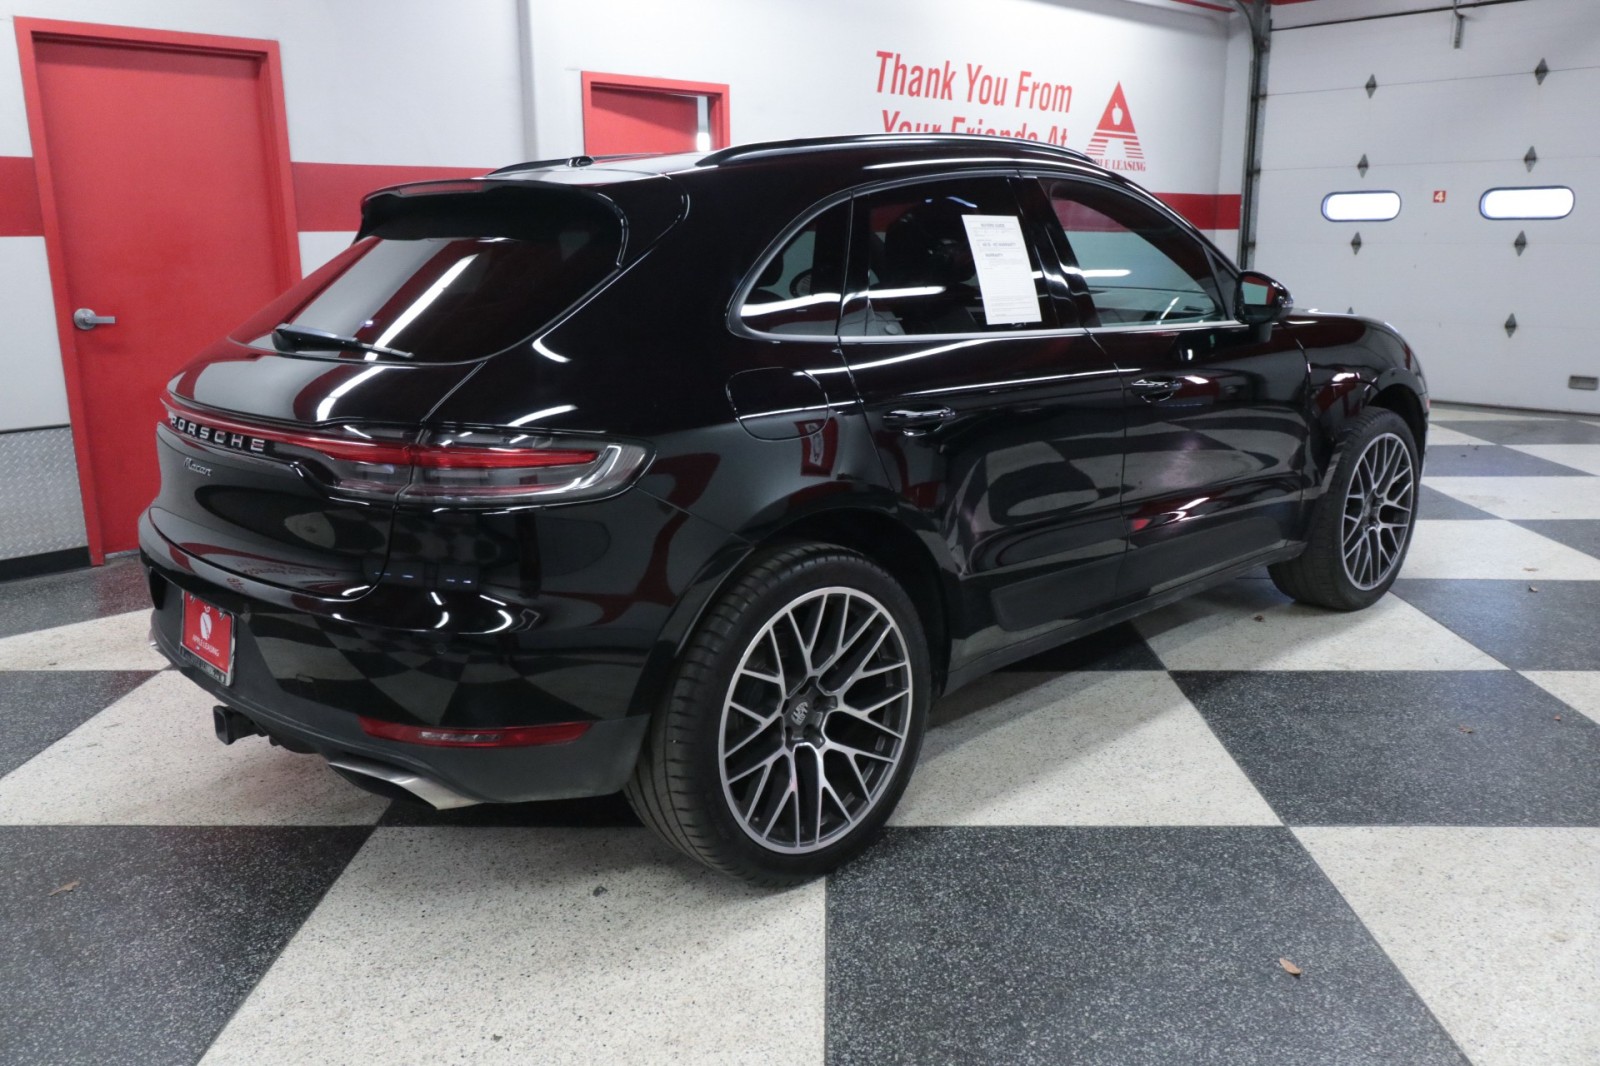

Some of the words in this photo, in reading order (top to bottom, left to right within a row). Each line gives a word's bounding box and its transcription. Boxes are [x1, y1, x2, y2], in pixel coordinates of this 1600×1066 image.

[876, 50, 957, 101] Thank
[967, 63, 1008, 107] You
[1015, 71, 1073, 113] From
[1112, 159, 1146, 172] LEASING
[1434, 191, 1445, 202] 4
[170, 415, 265, 452] PORSCHE
